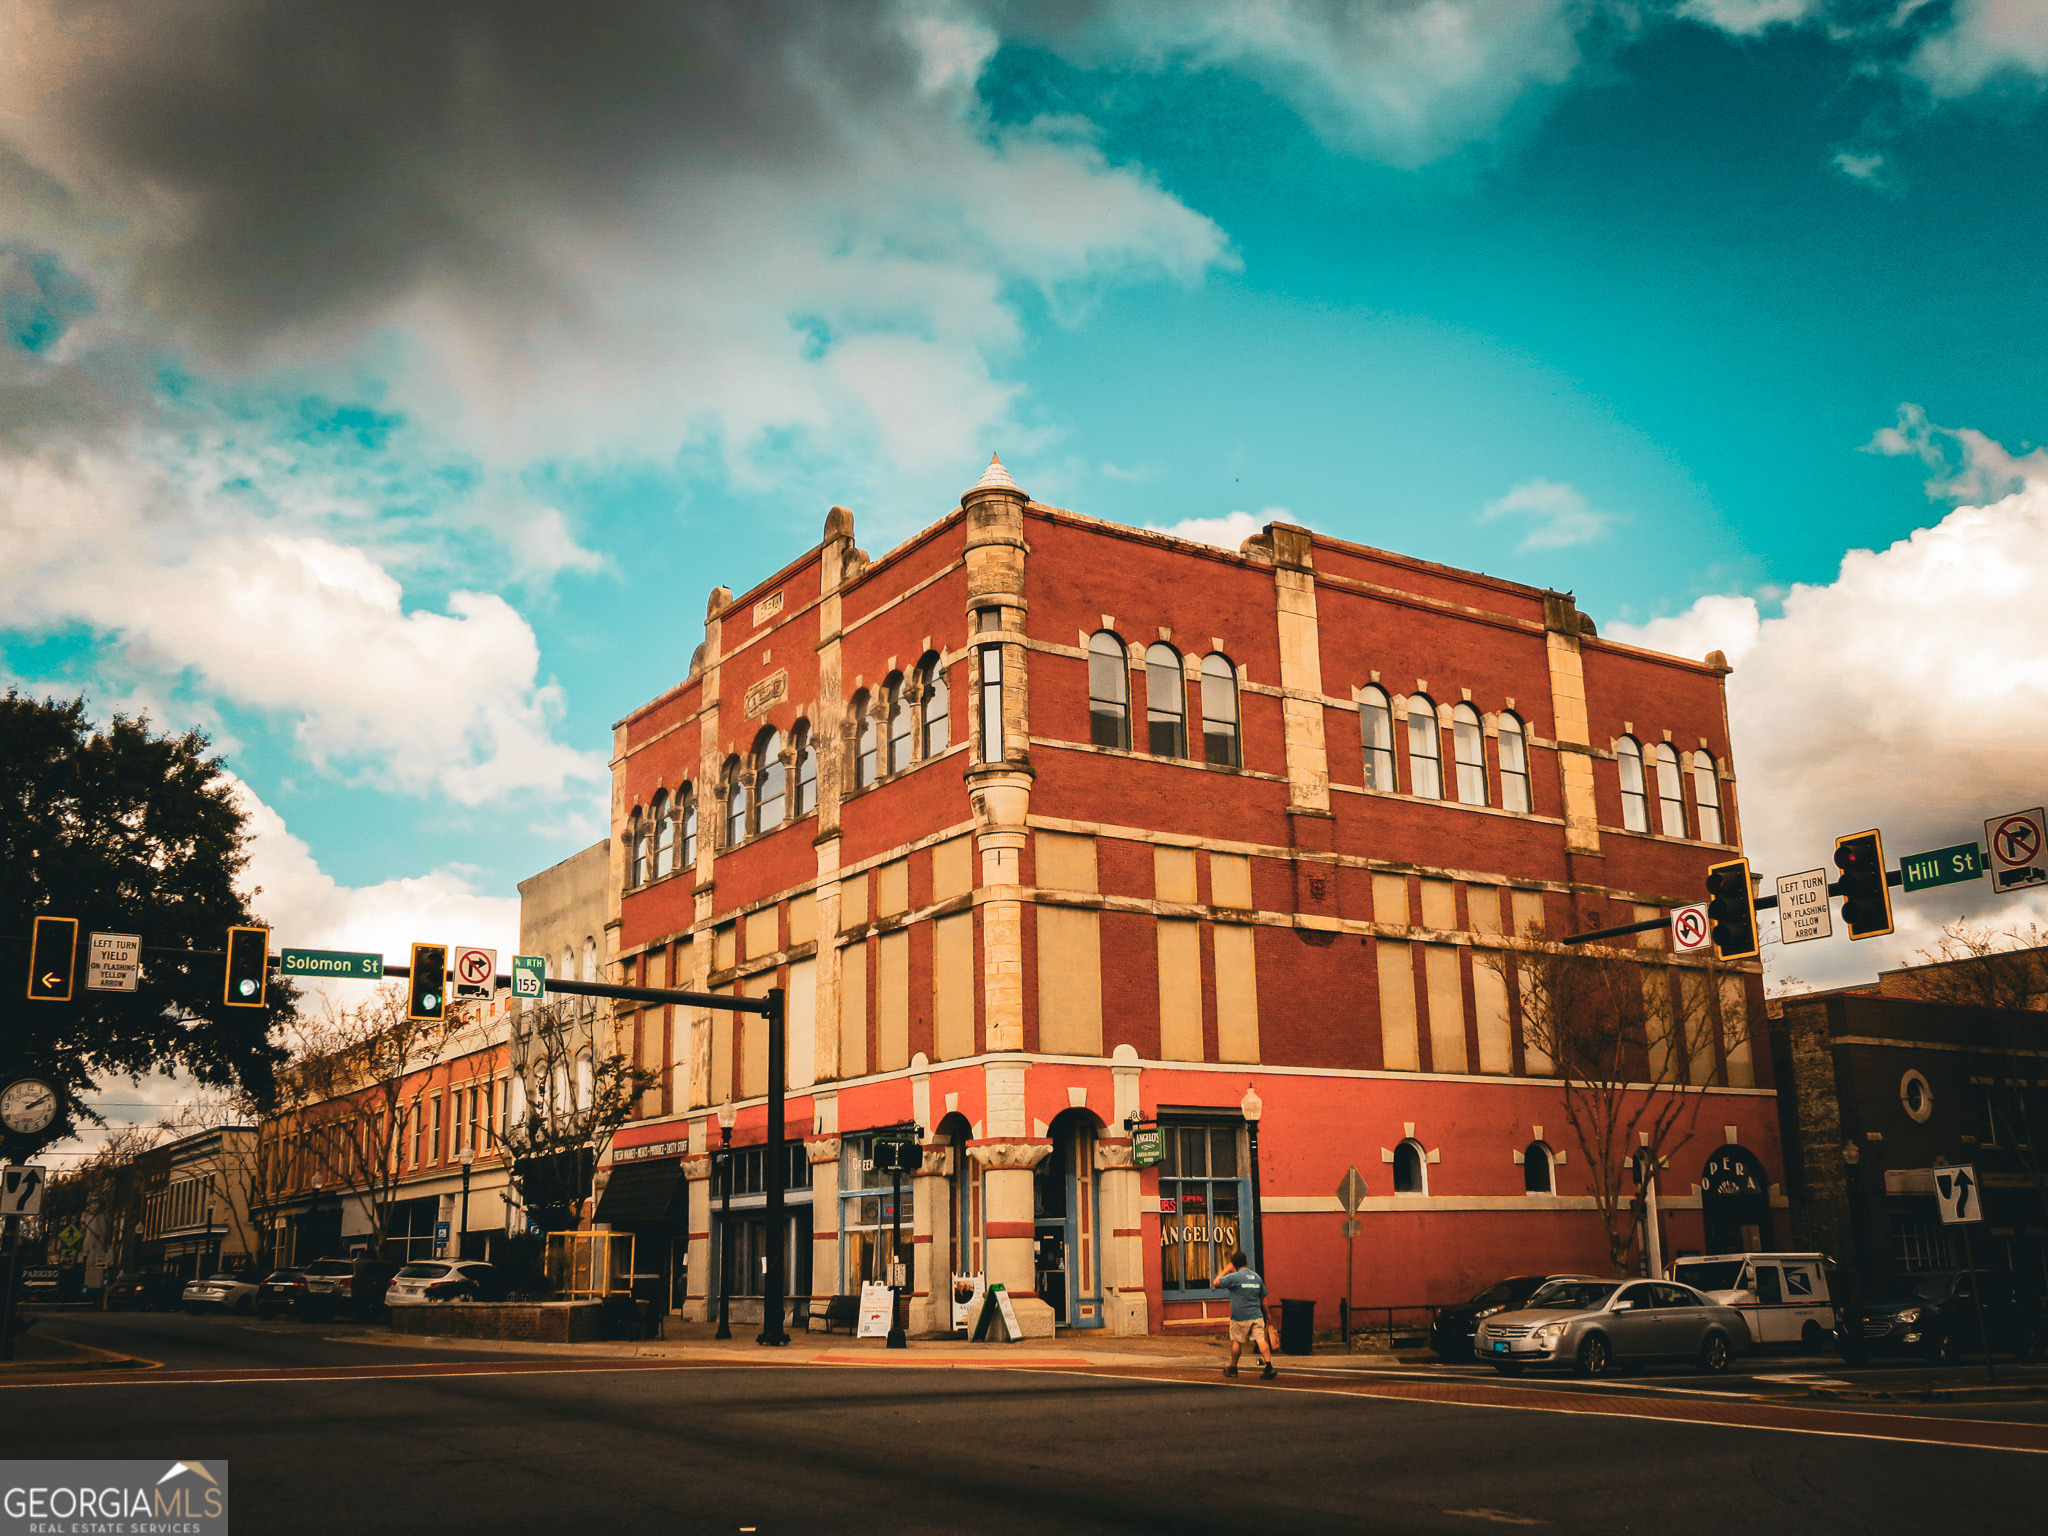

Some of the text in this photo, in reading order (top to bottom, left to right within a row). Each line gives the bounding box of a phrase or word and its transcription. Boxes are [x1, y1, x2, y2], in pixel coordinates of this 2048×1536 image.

[1908, 853, 1974, 882] Hill St
[1780, 877, 1824, 894] LEFT TURN
[1790, 892, 1816, 906] YIELD
[1782, 904, 1827, 920] ON FLASHING
[1793, 916, 1819, 928] YELLOW
[1795, 927, 1818, 938] ARROW
[93, 939, 137, 949] LEFT TURN
[101, 950, 128, 961] YIELD
[91, 962, 136, 971] ON FLASHING
[286, 955, 379, 973] Solomon St
[515, 958, 543, 967] NRTH
[101, 971, 127, 979] YELLOW
[100, 979, 124, 987] ARROW
[518, 978, 537, 992] 155
[1701, 1156, 1756, 1191] OPERA
[1160, 1224, 1235, 1247] ANGELO'S
[22, 1269, 59, 1278] PARKING
